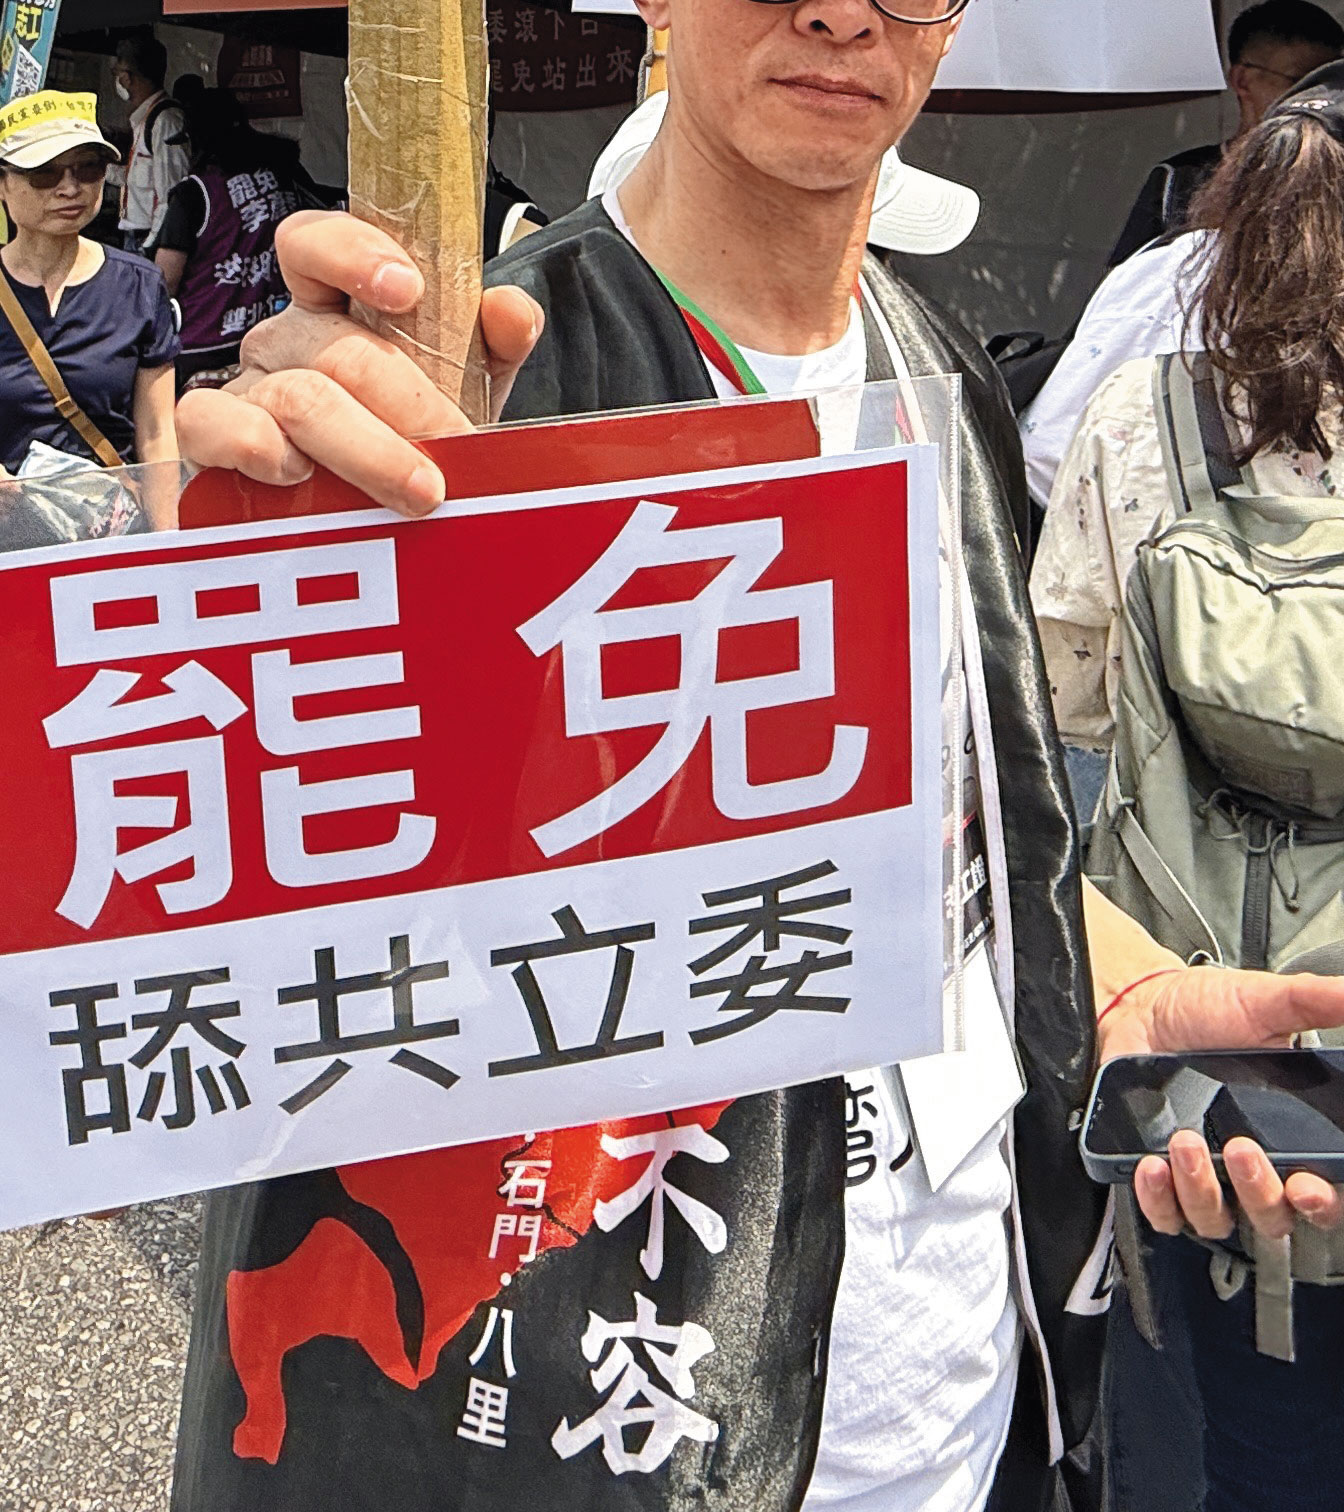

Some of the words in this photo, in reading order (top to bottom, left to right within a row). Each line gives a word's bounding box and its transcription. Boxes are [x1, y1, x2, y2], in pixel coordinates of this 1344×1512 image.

[14, 2, 43, 41] 志工
[41, 498, 872, 930] 罷免
[47, 859, 858, 1146] 舔共立委
